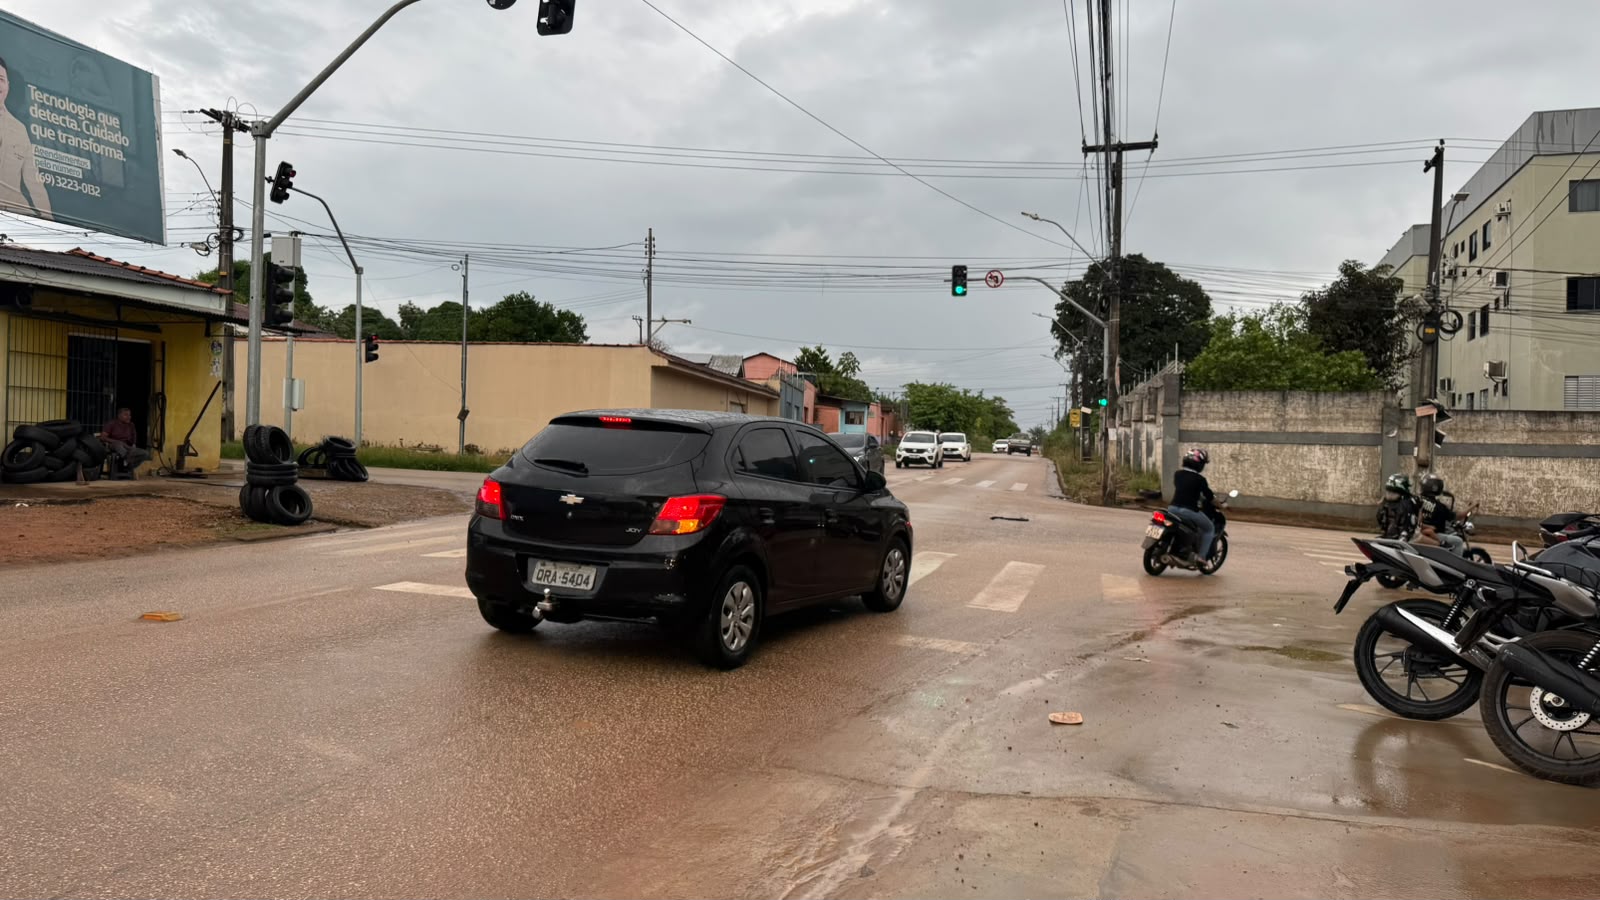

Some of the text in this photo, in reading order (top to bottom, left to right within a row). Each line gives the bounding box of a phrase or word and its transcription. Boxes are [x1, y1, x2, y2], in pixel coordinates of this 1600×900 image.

[28, 84, 120, 129] Tecnologia que
[29, 103, 130, 147] detecta. Cuidado
[30, 123, 127, 162] que transforma.
[34, 146, 89, 167] Agendamentos
[35, 159, 51, 170] pelo
